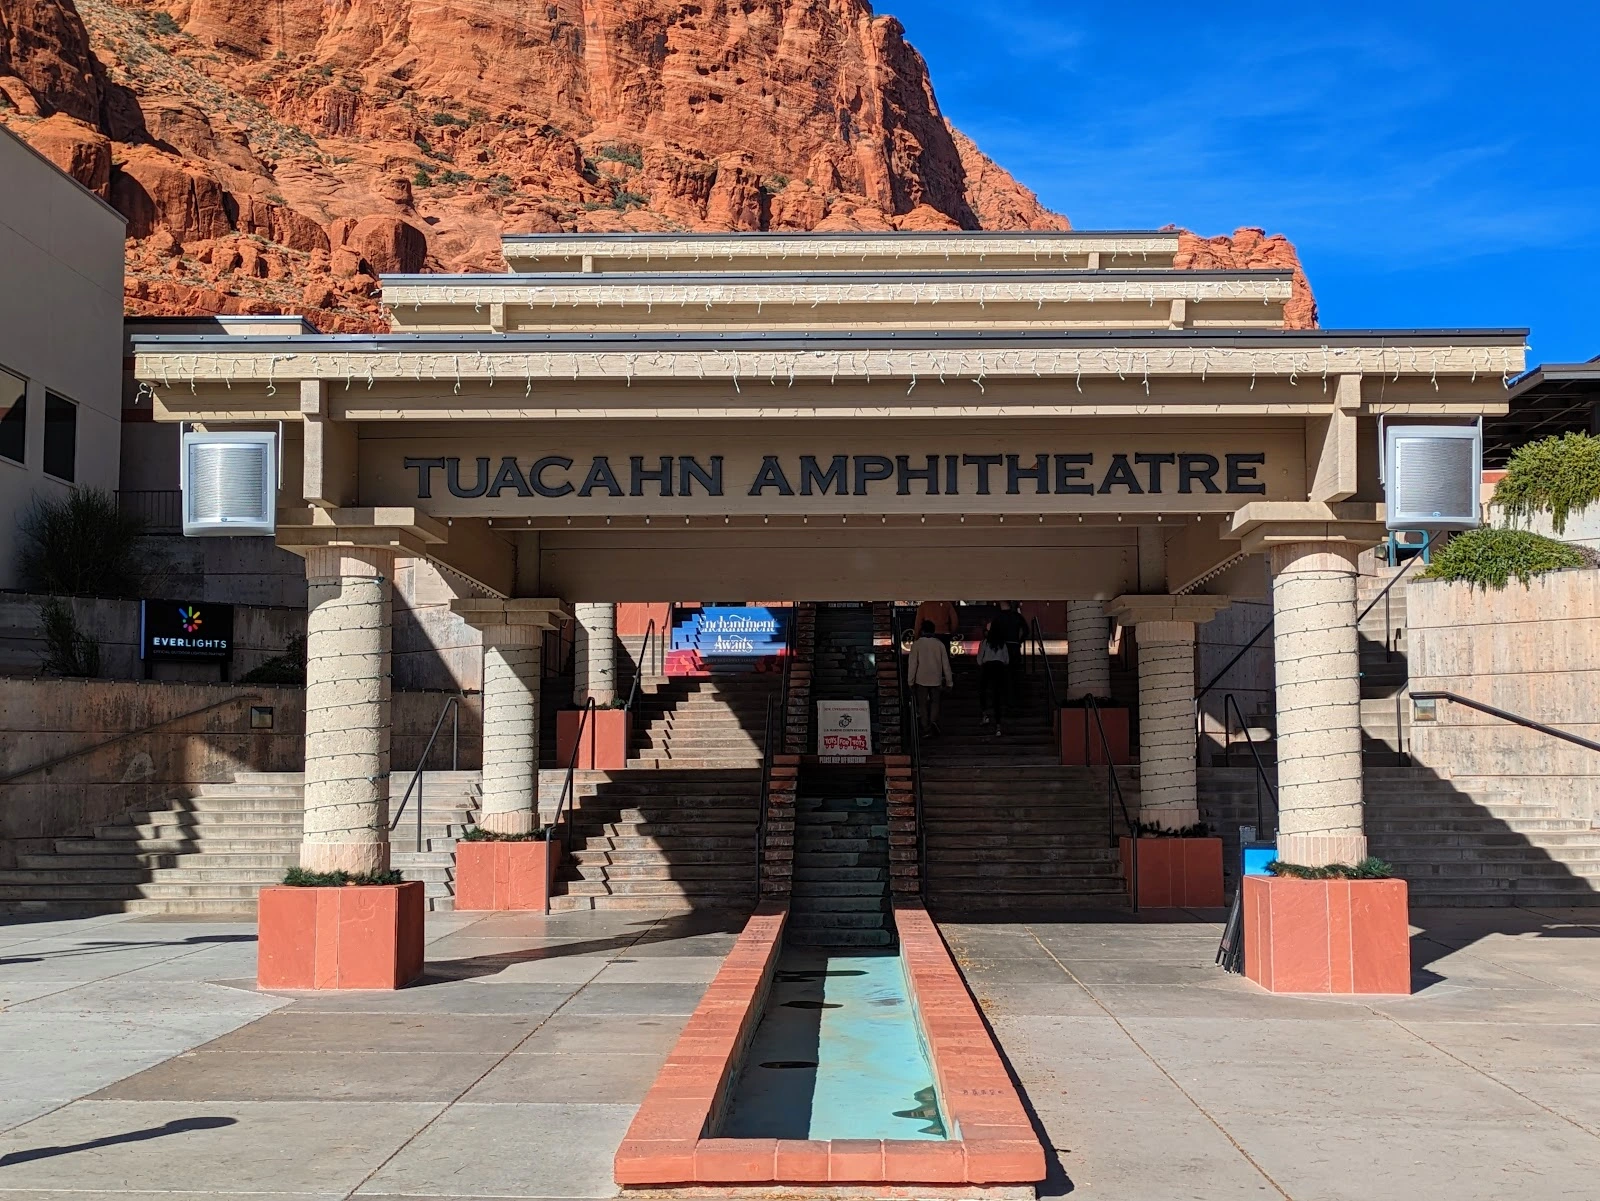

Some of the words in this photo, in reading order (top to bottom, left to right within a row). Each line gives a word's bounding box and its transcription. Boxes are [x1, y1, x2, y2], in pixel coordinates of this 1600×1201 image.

[403, 455, 724, 499] TUACAHN
[747, 452, 1267, 497] AMPHITHEATRE
[699, 614, 776, 633] Enchantment
[152, 636, 227, 649] EVERLIGHTS
[712, 634, 754, 654] Awaits
[825, 737, 837, 745] TOYS
[839, 738, 850, 746] FOR
[851, 739, 865, 748] TOTS
